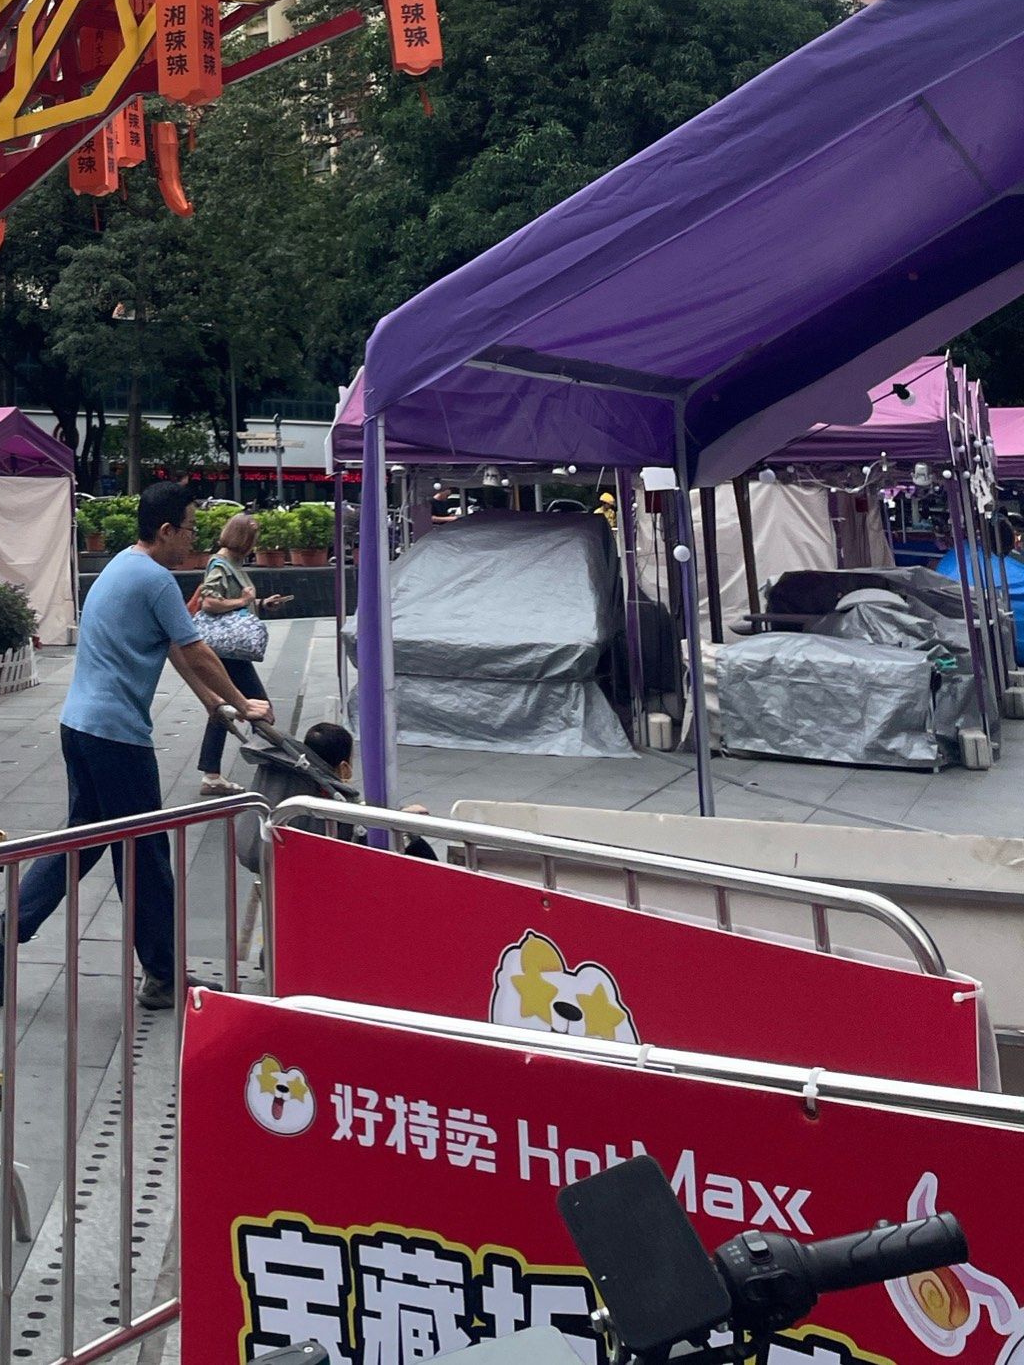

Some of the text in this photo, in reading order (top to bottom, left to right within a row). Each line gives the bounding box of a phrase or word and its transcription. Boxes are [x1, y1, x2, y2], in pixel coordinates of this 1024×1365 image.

[163, 4, 189, 76] 湘辣辣
[200, 4, 217, 76] 湘辣辣
[330, 1083, 498, 1174] 好特卖
